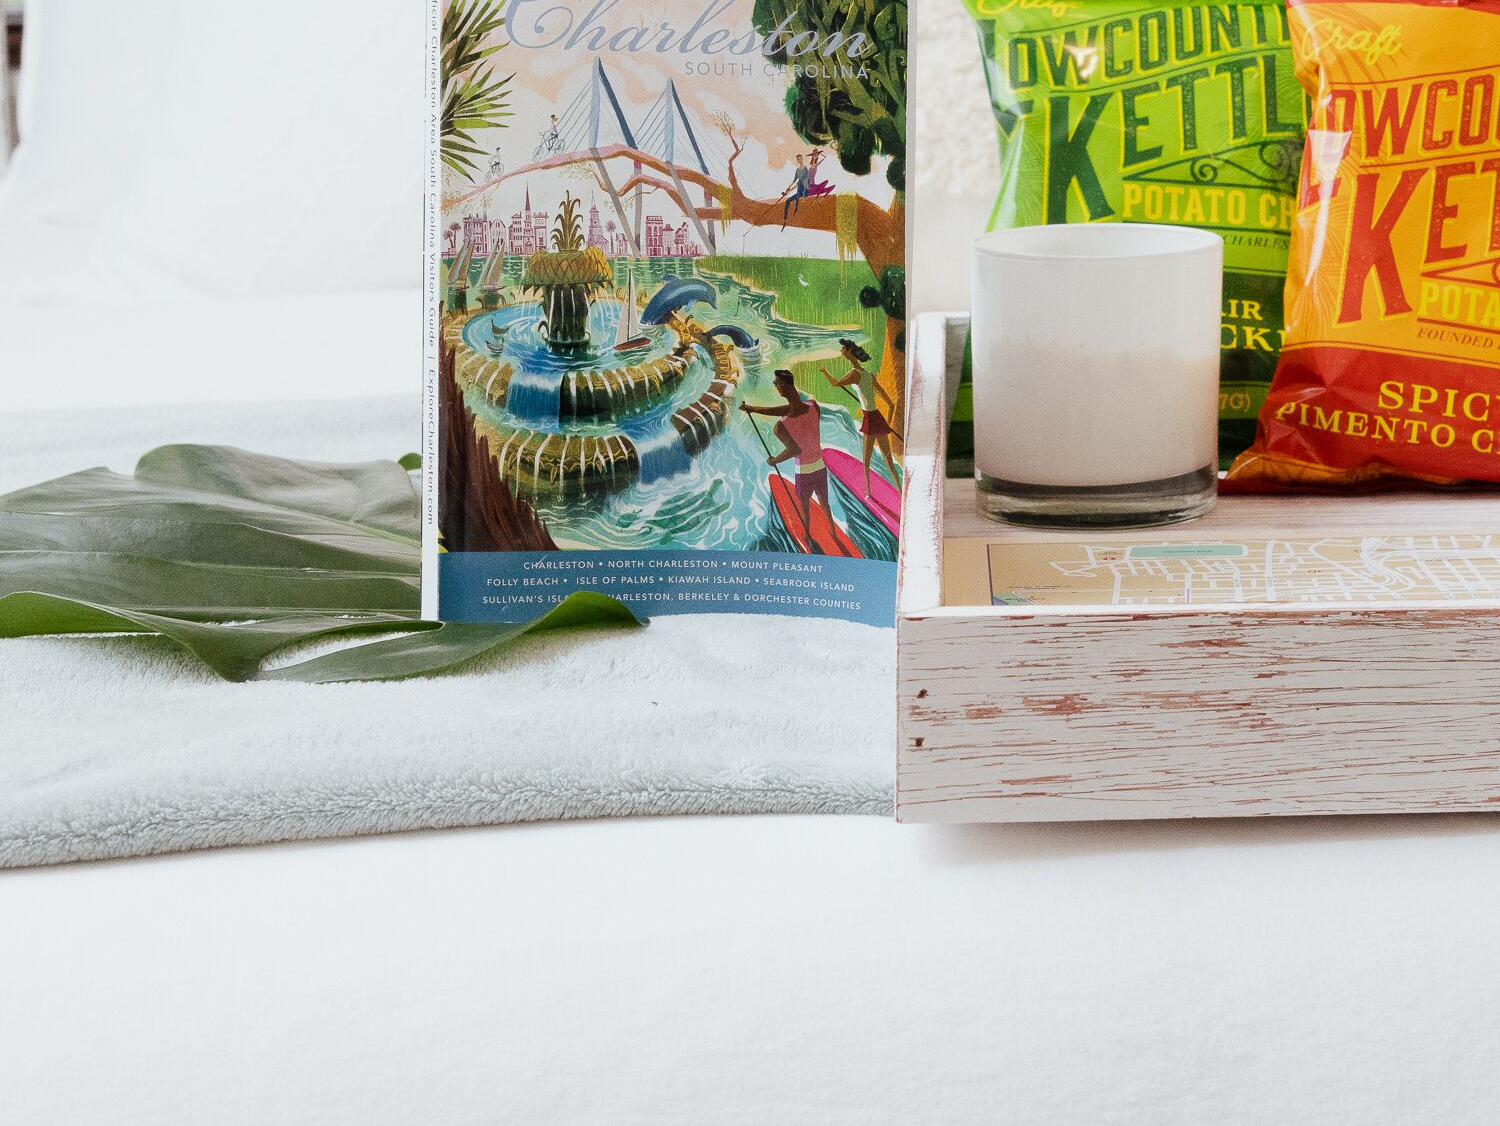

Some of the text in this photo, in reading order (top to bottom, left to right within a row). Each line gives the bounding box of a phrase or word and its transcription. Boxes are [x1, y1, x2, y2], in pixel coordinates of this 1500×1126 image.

[1303, 18, 1403, 66] Craft
[430, 35, 438, 109] Charleston
[684, 60, 870, 81] SOUTH CAROLINA
[430, 113, 438, 145] Area
[429, 149, 437, 188] South
[429, 192, 437, 249] Carolina
[1122, 184, 1247, 226] POTATO
[428, 253, 436, 303] Visitors
[428, 307, 436, 348] Guide
[1221, 298, 1264, 321] IR
[1416, 326, 1495, 349] FOUNDED
[1274, 400, 1457, 449] PIMENTO
[486, 575, 855, 593] FOLLY BEACH ISLE OF PALMS KIAWAH ISLAND SEABROOK ISLAND
[523, 559, 823, 574] CHARLESTON NORTH CHARLESTON MOUNT PLEASANT
[482, 594, 545, 606] SULLIVAN'S
[607, 592, 675, 604] HARLESTON,
[678, 593, 731, 604] BERKELEY
[733, 593, 742, 603] &
[743, 593, 812, 606] DORCHESTER
[813, 598, 862, 611] COUNTIES
